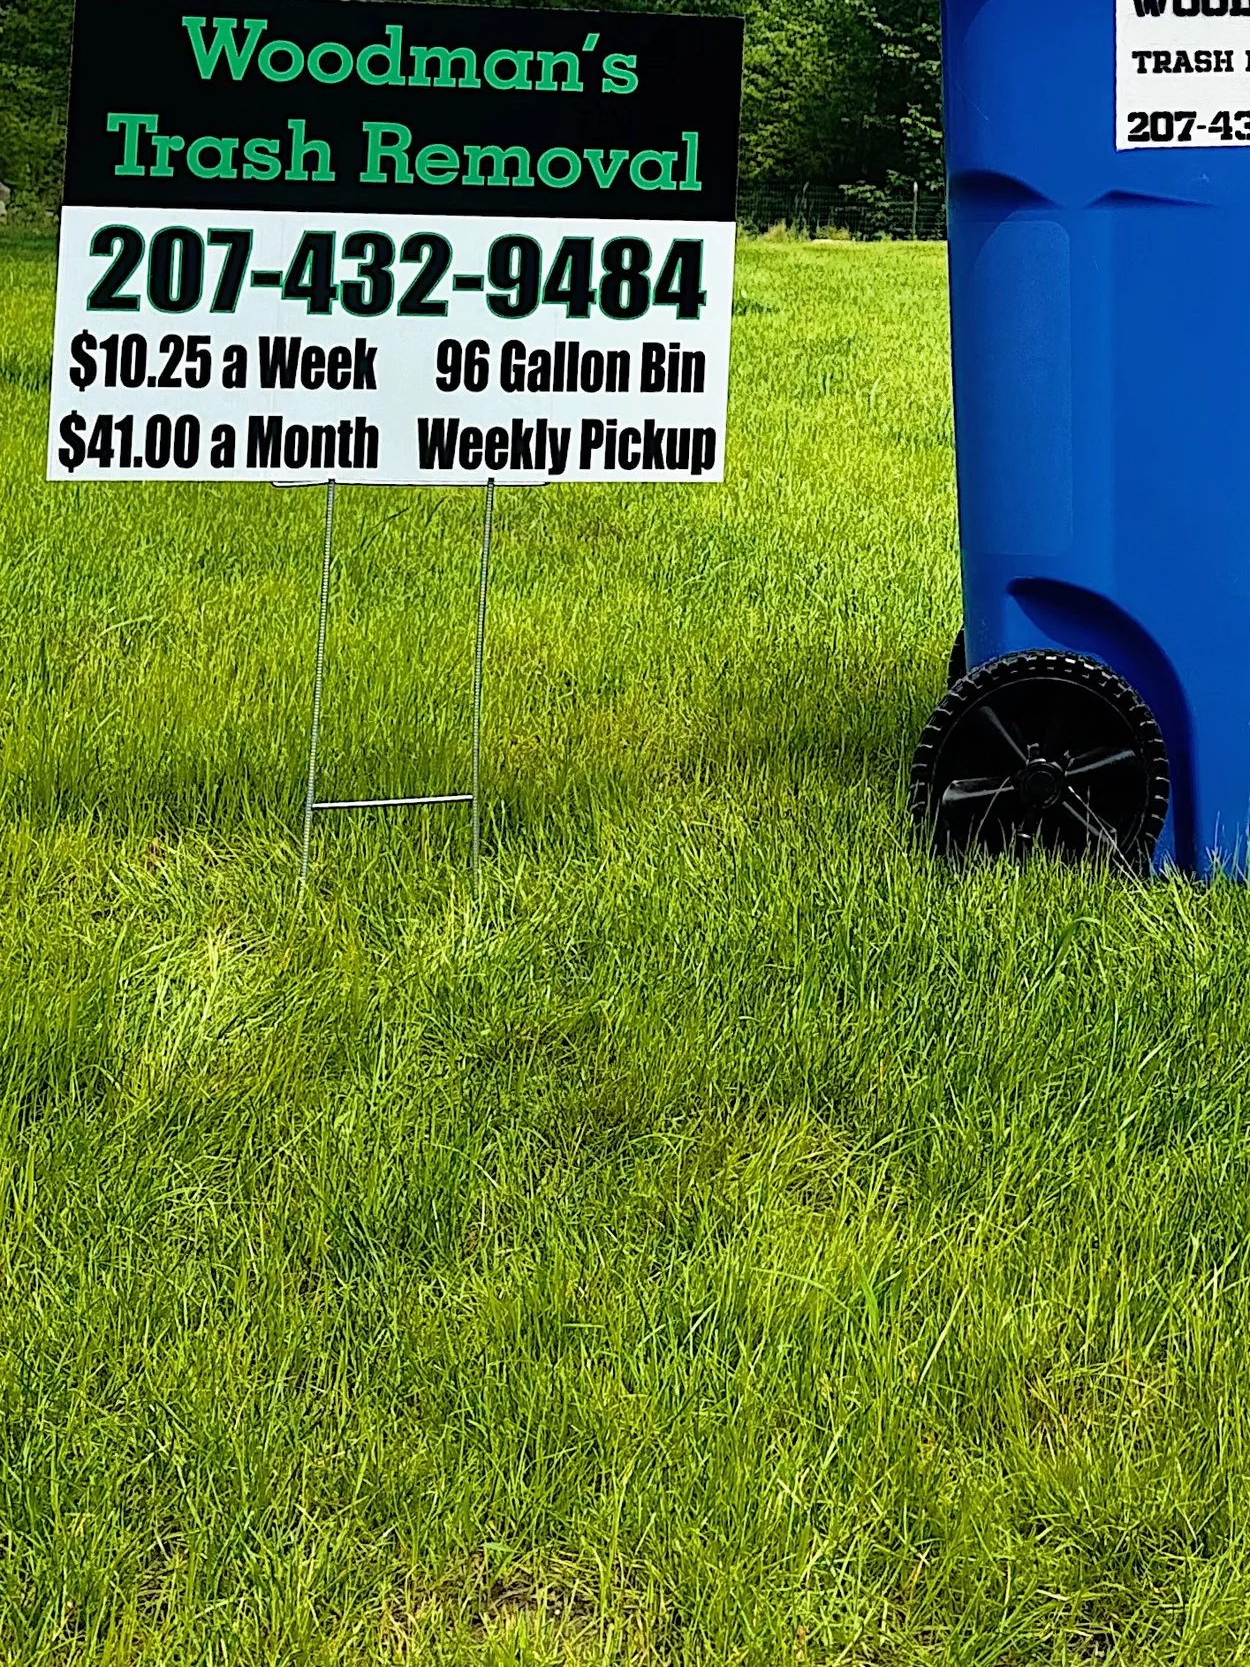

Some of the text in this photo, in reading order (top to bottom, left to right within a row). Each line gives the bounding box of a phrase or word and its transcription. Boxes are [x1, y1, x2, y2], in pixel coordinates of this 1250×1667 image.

[182, 17, 639, 94] Woodman's
[1132, 51, 1233, 73] TRASH
[107, 113, 702, 191] Trash Removal
[86, 225, 707, 320] 207-432-9484
[69, 331, 377, 392] $10.25 a Week
[436, 339, 705, 393] 96 Gallon Bin
[58, 411, 379, 472] $41.00 a Month
[418, 418, 716, 478] Weekly Pickup
